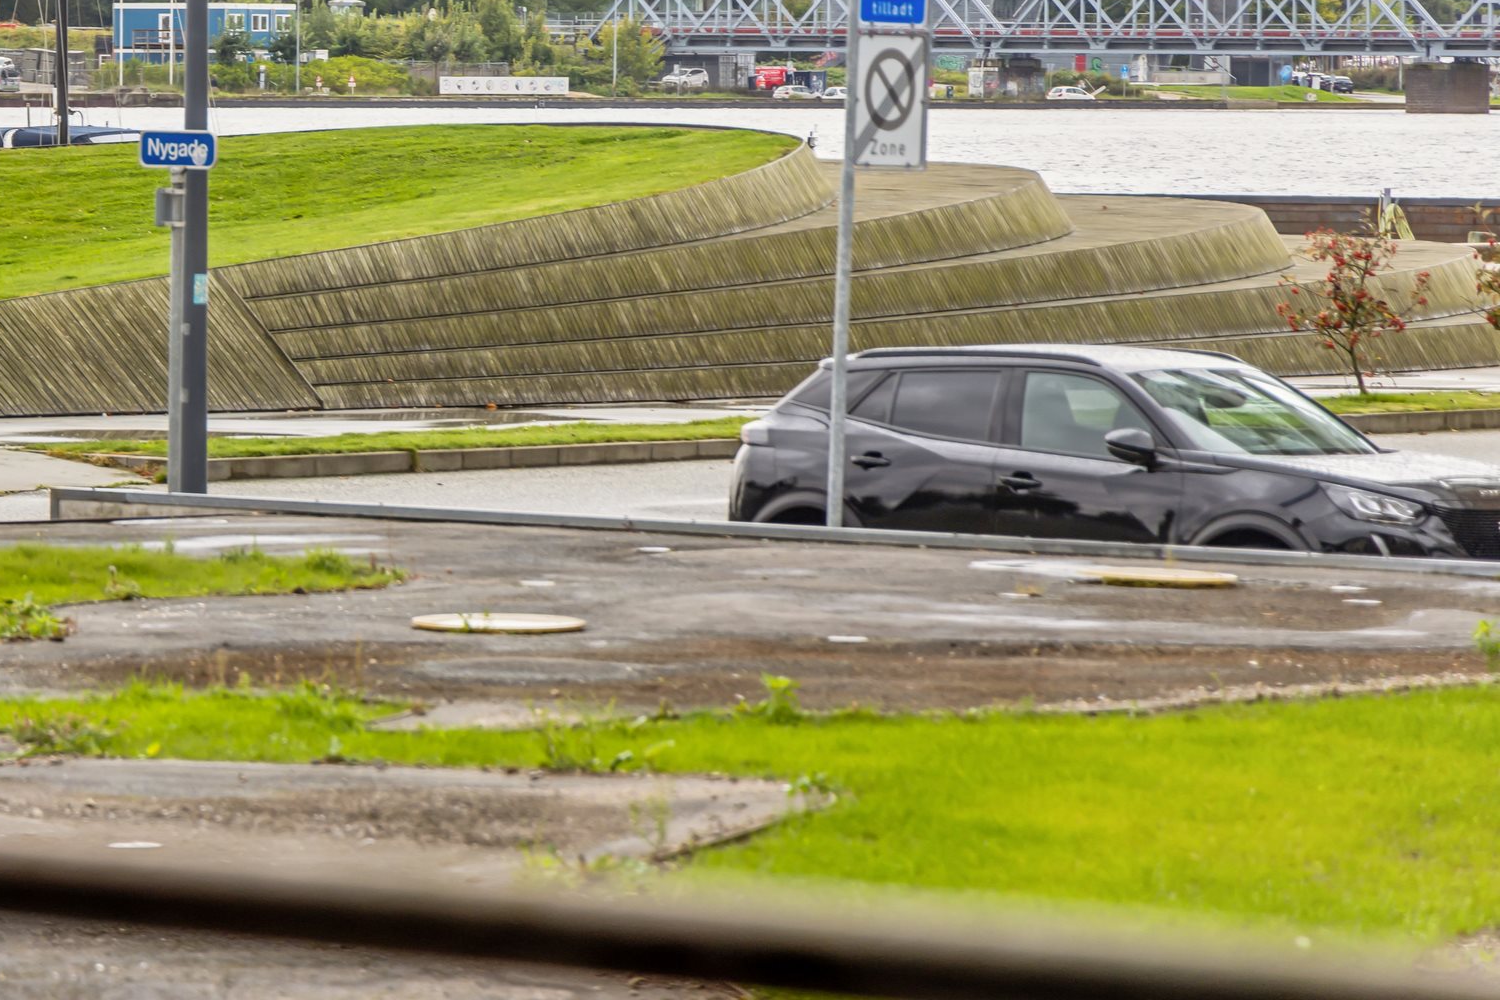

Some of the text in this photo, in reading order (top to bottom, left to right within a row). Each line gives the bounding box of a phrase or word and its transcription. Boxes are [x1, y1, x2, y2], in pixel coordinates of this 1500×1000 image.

[872, 1, 913, 17] tilladt
[147, 137, 209, 161] Nygade
[869, 138, 906, 156] Zone
